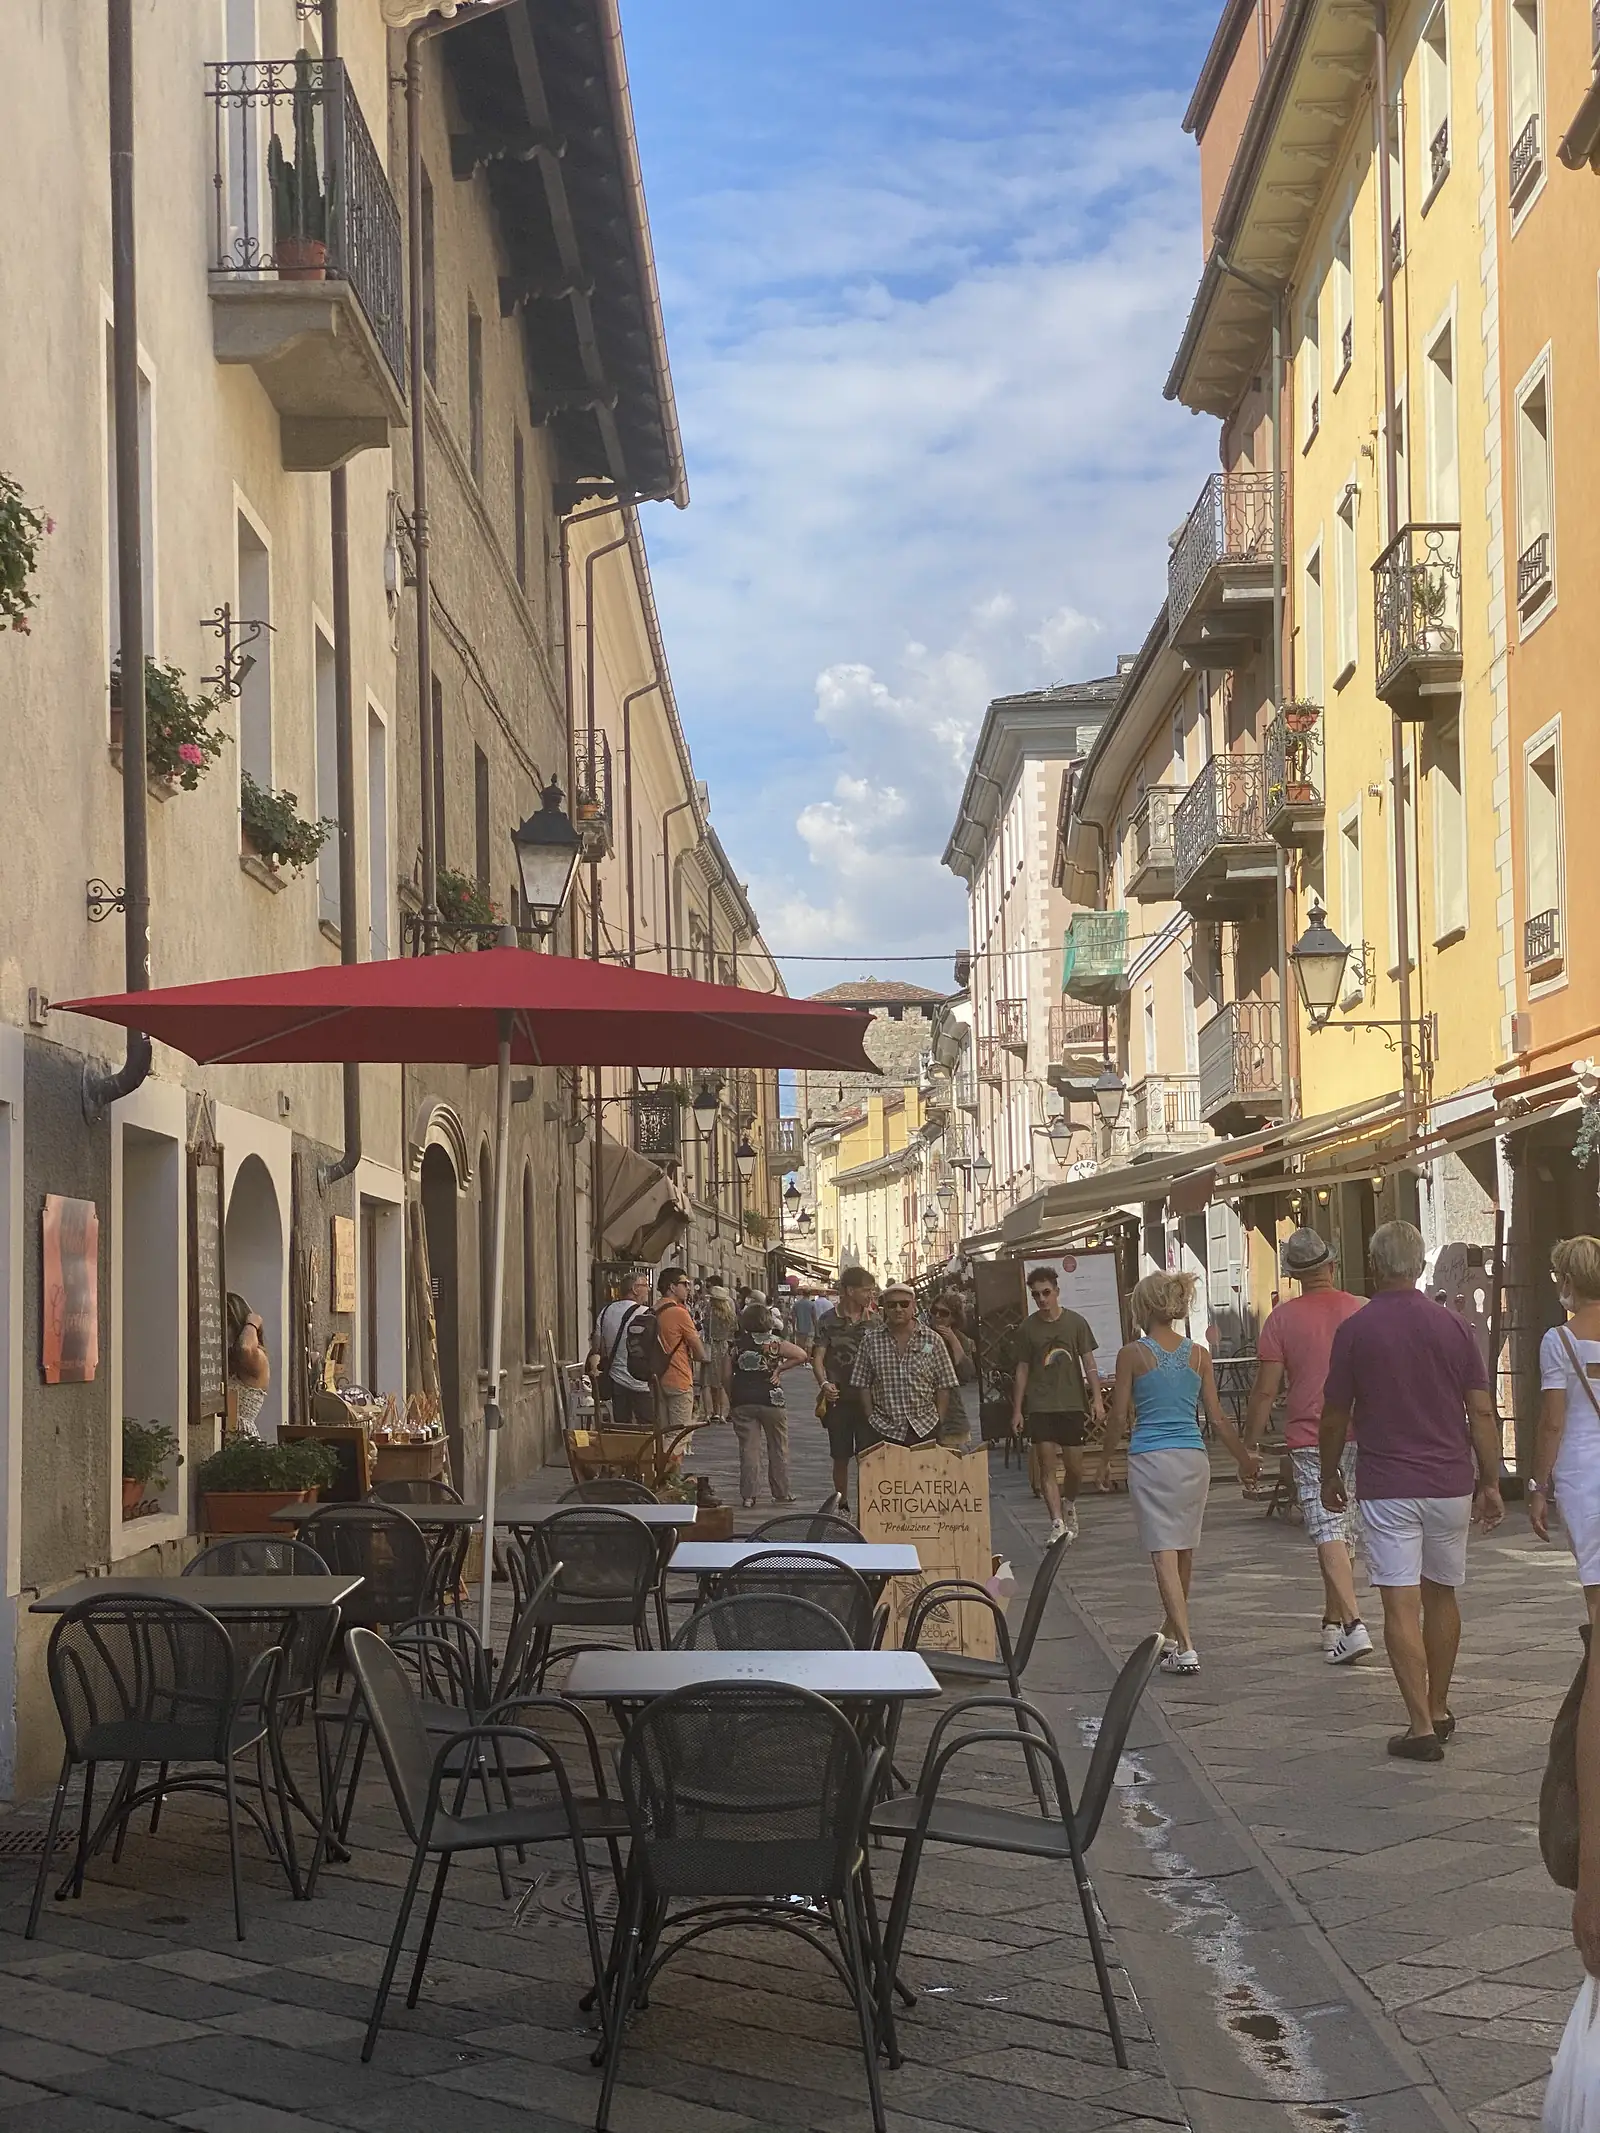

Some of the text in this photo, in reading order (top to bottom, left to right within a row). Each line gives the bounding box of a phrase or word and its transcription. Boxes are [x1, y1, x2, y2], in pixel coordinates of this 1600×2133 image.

[877, 1480, 971, 1495] GELATERIA
[867, 1498, 982, 1513] ARTIGIANALE
[880, 1522, 970, 1533] Produzione Propria
[919, 1629, 955, 1638] OCOLAT
